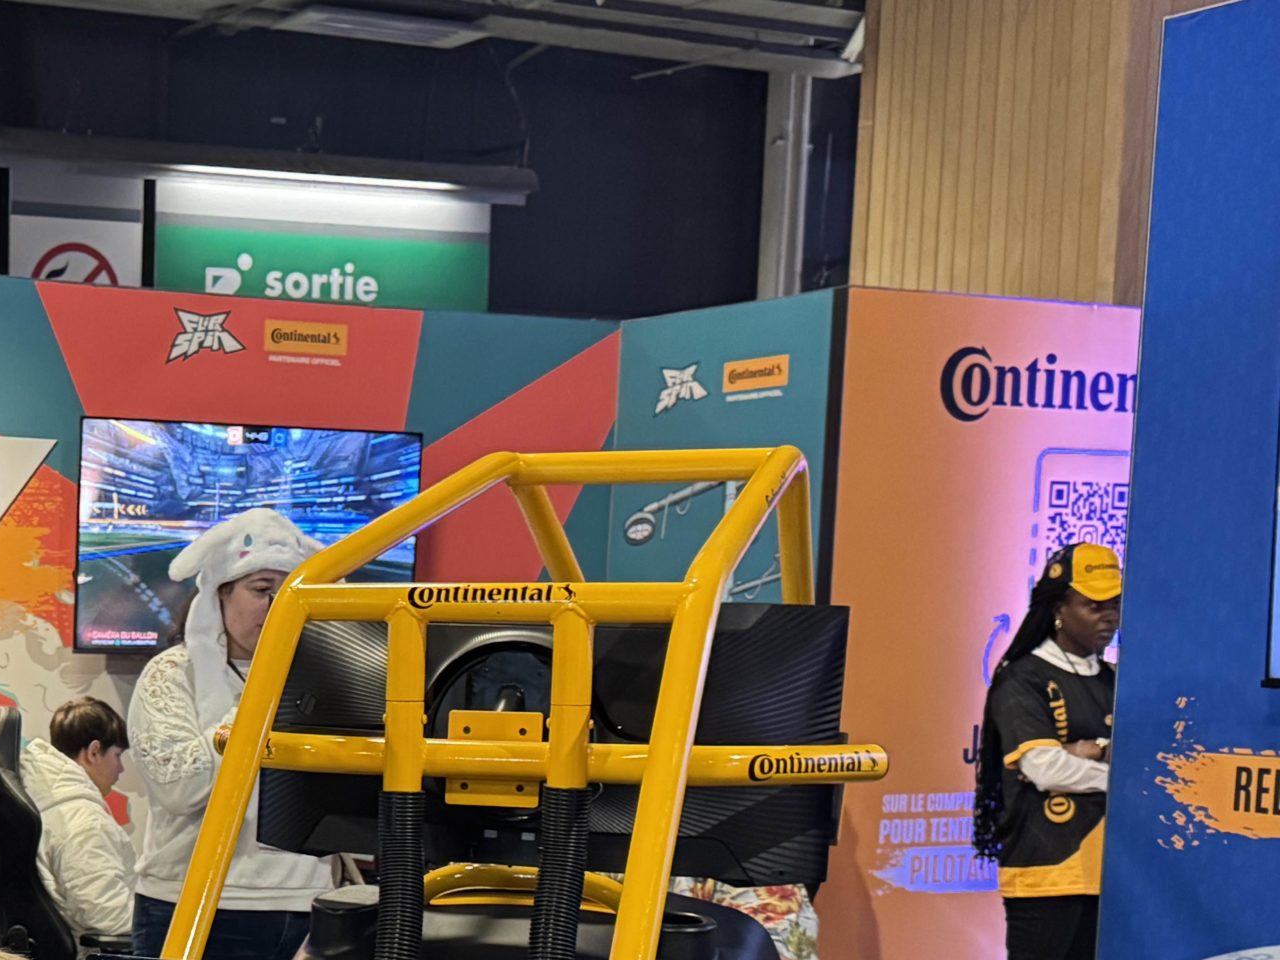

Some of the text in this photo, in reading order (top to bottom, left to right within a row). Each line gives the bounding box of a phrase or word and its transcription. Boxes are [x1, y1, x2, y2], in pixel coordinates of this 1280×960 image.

[264, 262, 379, 302] sortie
[271, 328, 331, 344] Continental
[728, 364, 775, 384] Continental
[407, 584, 553, 609] Continental
[748, 751, 862, 782] Continental
[882, 794, 907, 813] SUR
[911, 793, 925, 812] LE
[879, 819, 926, 844] POUR
